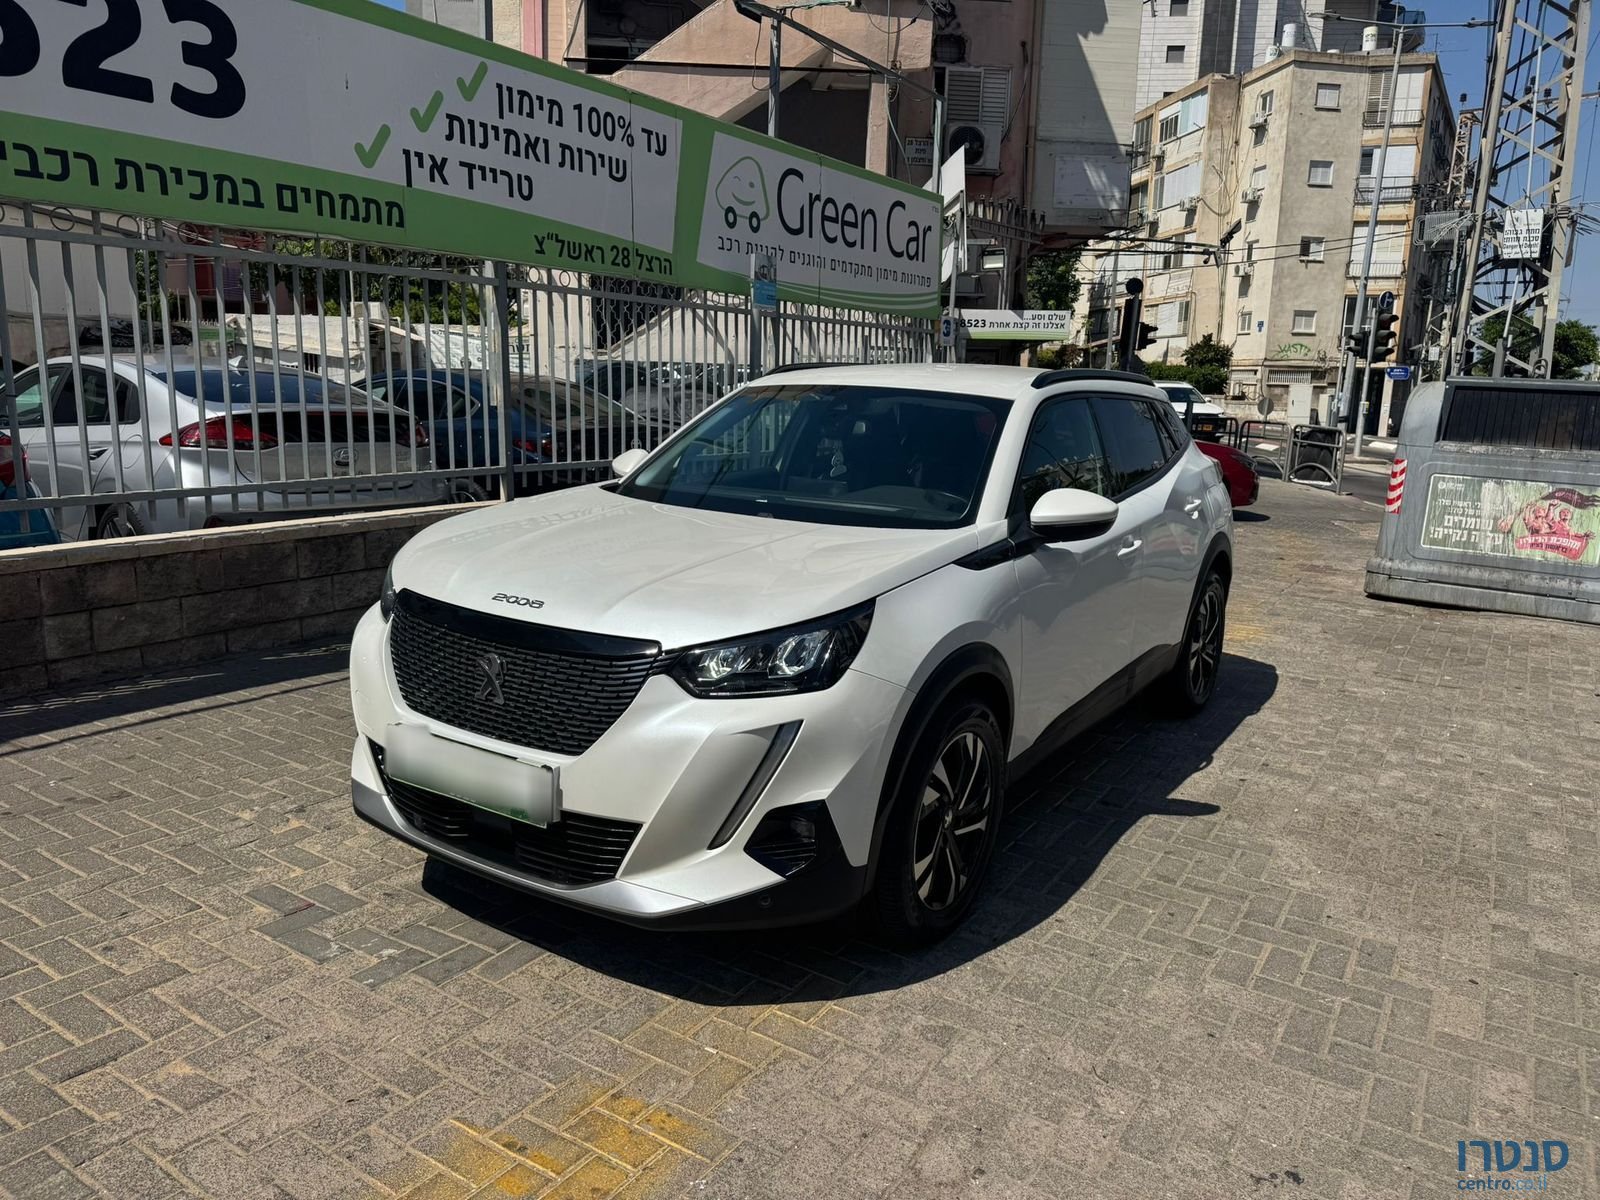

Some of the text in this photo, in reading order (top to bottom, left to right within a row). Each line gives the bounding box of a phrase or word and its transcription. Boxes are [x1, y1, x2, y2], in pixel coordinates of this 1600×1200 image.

[496, 82, 668, 157] עד 100% מימון
[445, 112, 628, 183] שירות ואמינות
[114, 157, 265, 209] במכירת
[402, 148, 534, 201] טרייד אין
[275, 182, 405, 228] מתמחים
[776, 167, 932, 263] Green Car
[717, 235, 741, 254] רכב
[610, 244, 631, 268] 28
[635, 248, 673, 276] הרצל
[789, 250, 826, 269] והוגנים
[830, 258, 873, 278] מתקדמים
[875, 266, 898, 283] מימון
[900, 271, 932, 288] פתרונות
[988, 321, 1011, 329] אחרת
[1012, 321, 1030, 330] קצת
[1031, 321, 1041, 329] זה
[1043, 321, 1066, 329] אצלנו
[1047, 313, 1066, 321] שלם
[491, 593, 545, 609] 2008
